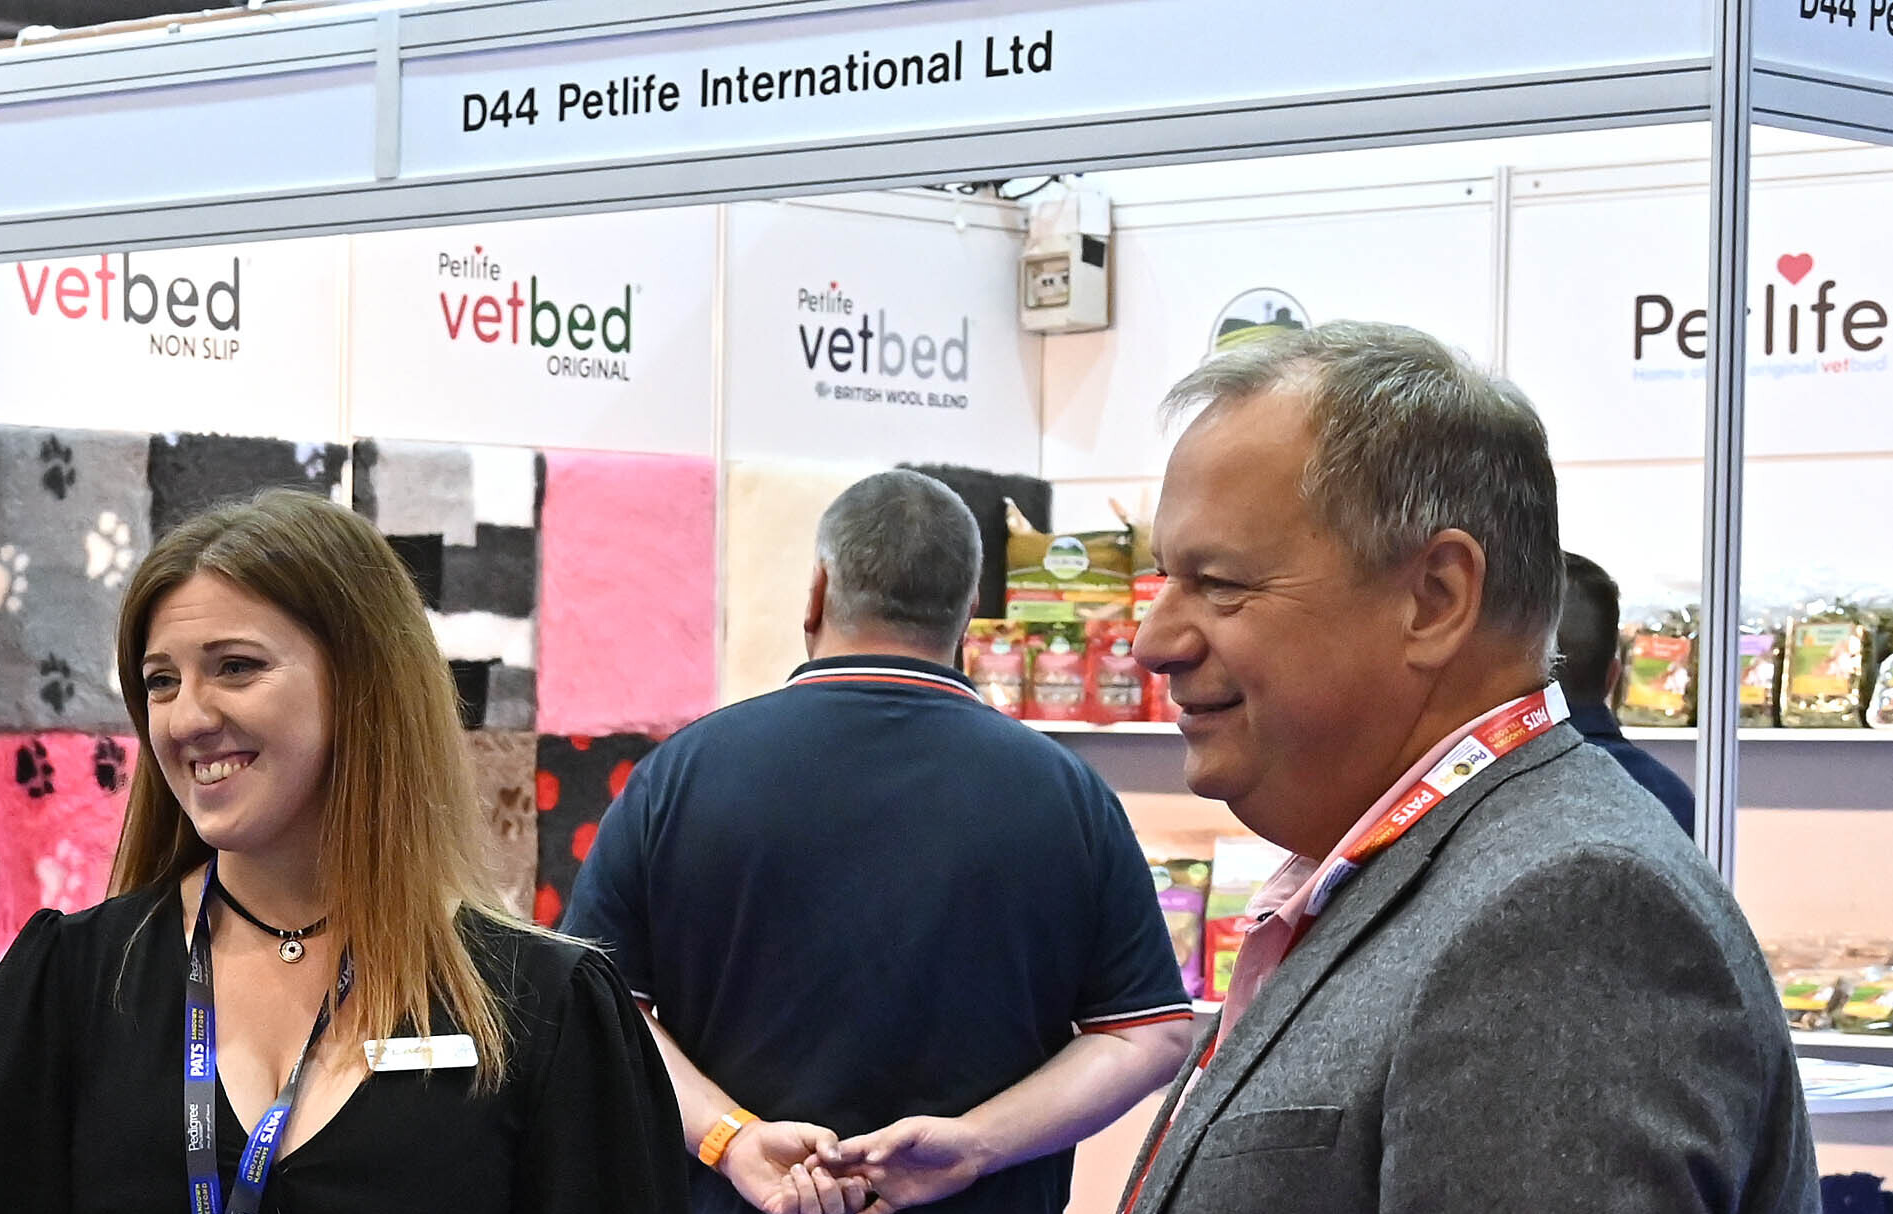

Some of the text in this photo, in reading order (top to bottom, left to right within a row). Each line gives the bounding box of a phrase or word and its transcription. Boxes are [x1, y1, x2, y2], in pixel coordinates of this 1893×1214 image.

[462, 30, 1054, 131] D44 Petlife International Ltd
[438, 248, 501, 281] Petlife
[16, 252, 240, 331] vetbed
[798, 284, 854, 316] Petlife
[440, 275, 631, 353] vetbed
[1634, 278, 1888, 361] Pelife
[150, 333, 240, 361] NON SLIP
[799, 308, 968, 383] vetbed
[547, 355, 631, 382] ORIGINAL
[1821, 355, 1887, 374] vetbed
[834, 385, 969, 409] BRITISH WOOL BLEND
[1521, 705, 1549, 731] PATS
[1391, 789, 1435, 826] PATS
[190, 1043, 205, 1077] PATS
[188, 1103, 199, 1153] Pedigree
[259, 1110, 284, 1145] PATS
